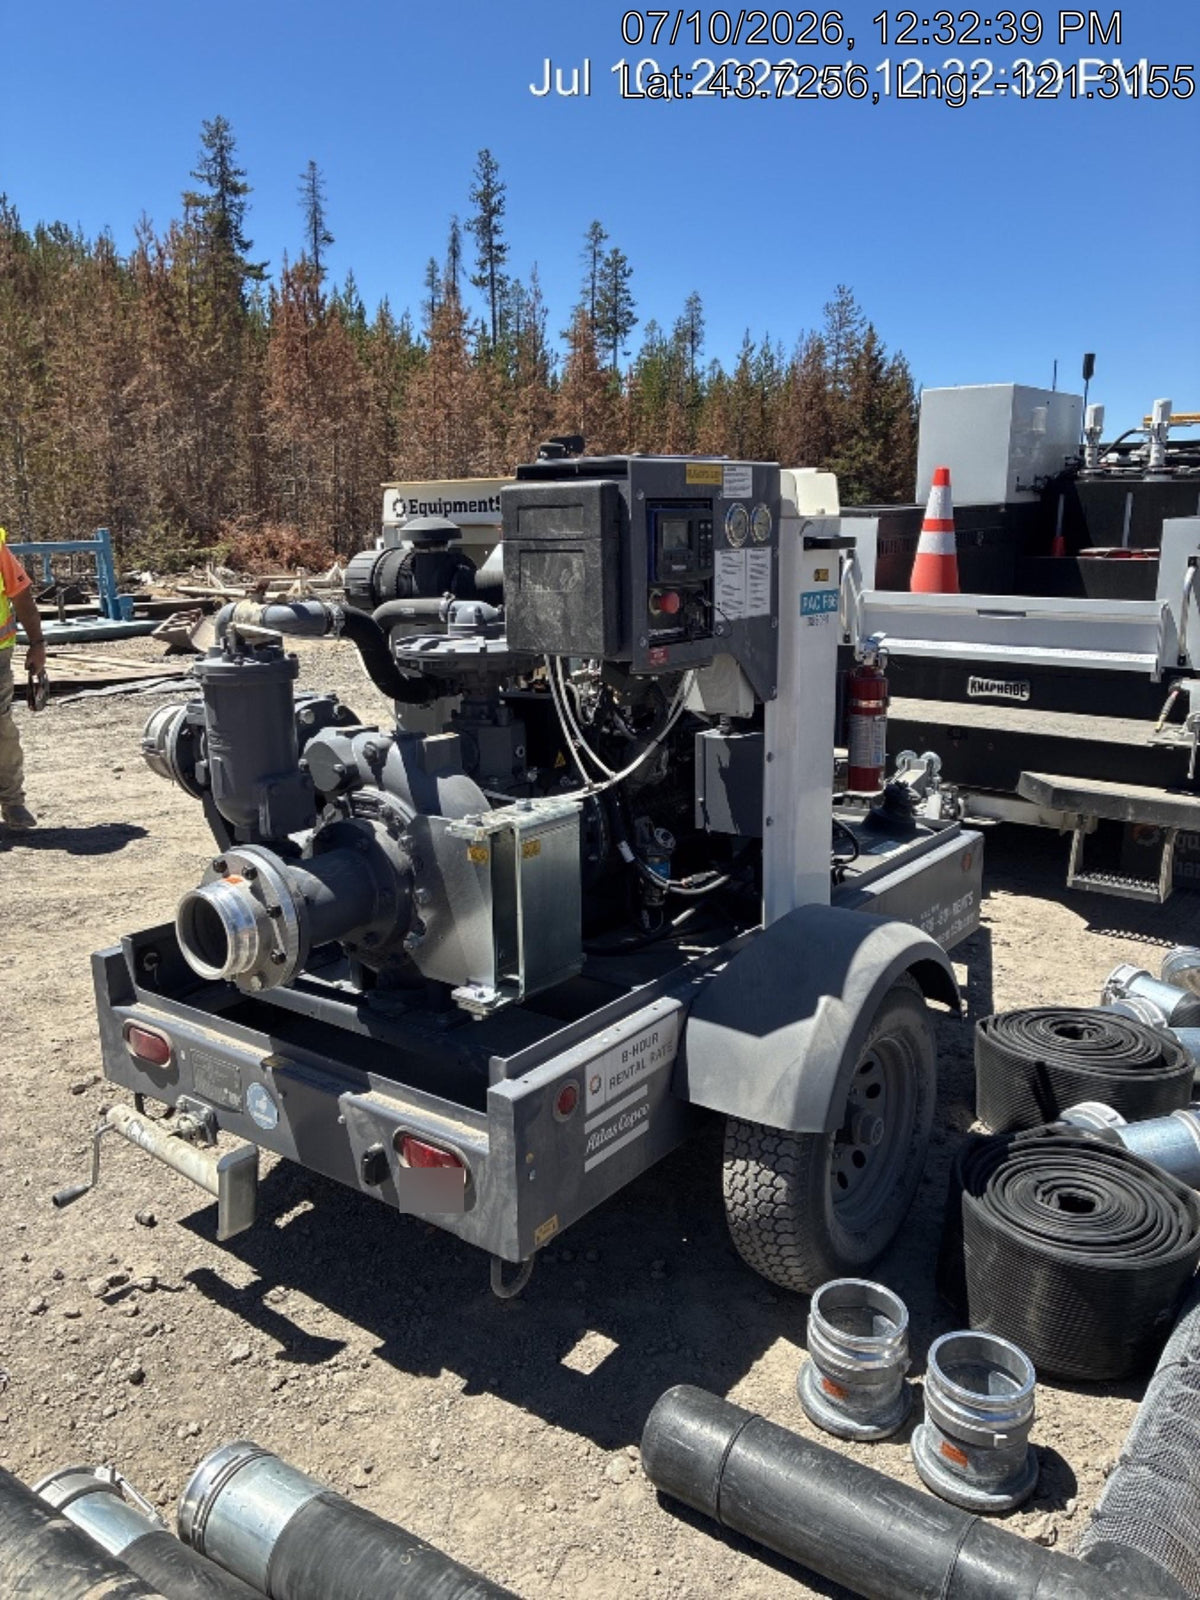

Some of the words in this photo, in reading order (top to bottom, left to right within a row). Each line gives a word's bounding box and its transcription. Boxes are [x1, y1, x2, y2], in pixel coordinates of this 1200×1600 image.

[970, 679, 1027, 698] KNAPHEIDE
[609, 1059, 646, 1090] RENTAL
[651, 1040, 673, 1064] RATE
[586, 1125, 618, 1154] Atlas
[619, 1103, 650, 1131] Copco
